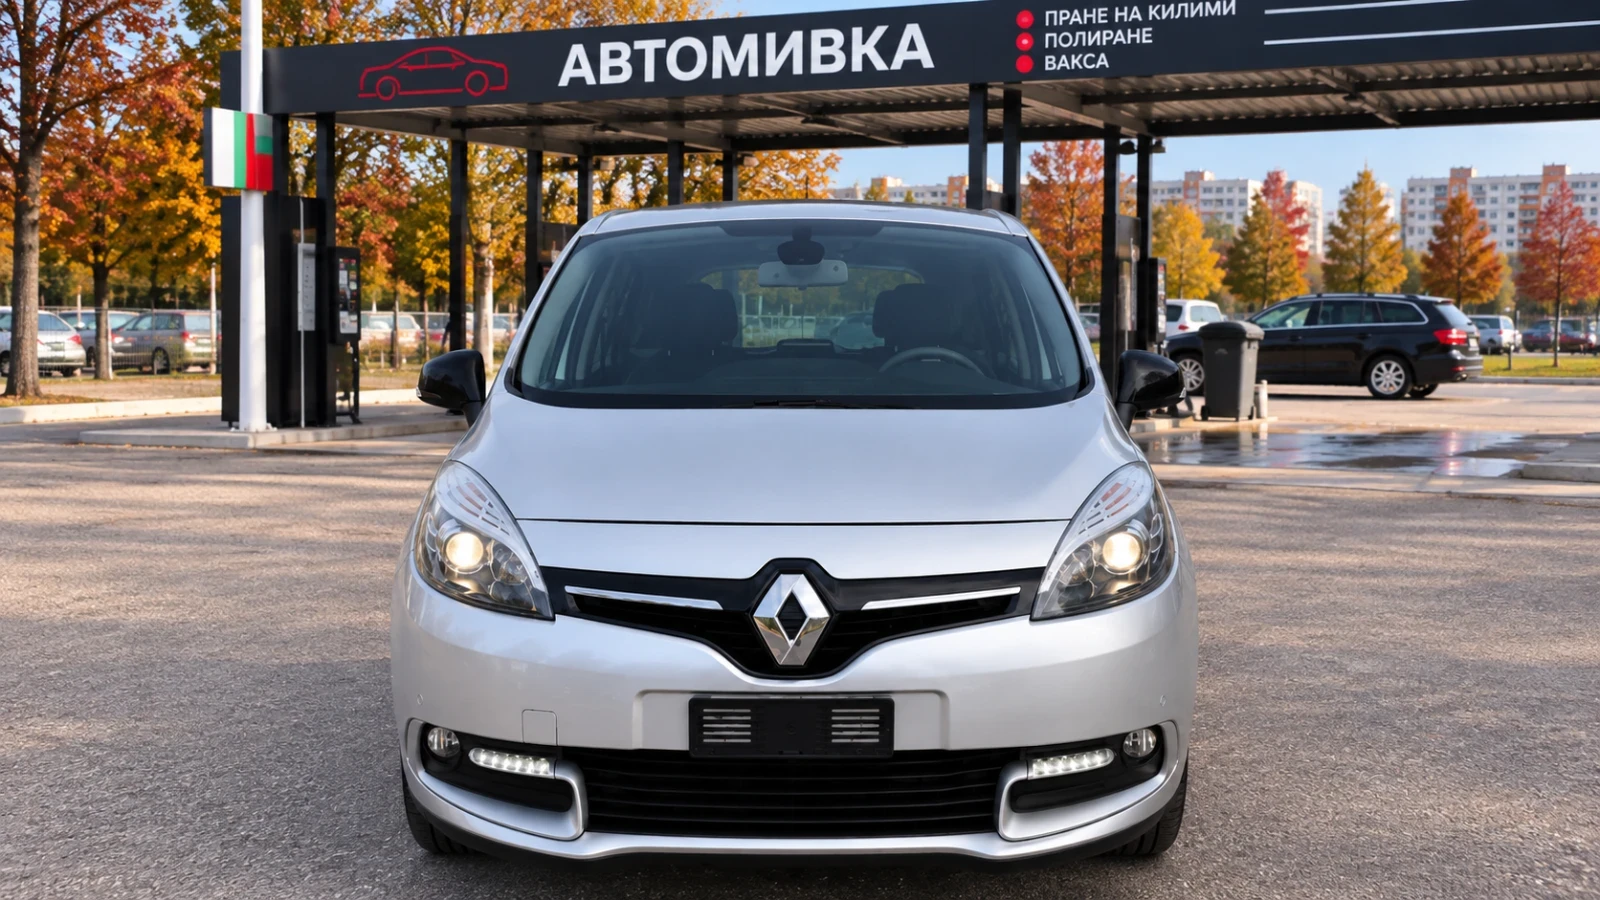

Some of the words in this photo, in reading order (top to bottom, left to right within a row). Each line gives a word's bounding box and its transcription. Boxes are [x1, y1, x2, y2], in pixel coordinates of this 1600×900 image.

[1044, 7, 1109, 27] ПРАНЕ
[1114, 5, 1143, 23] НА
[1148, 0, 1237, 21] КИЛИМИ
[1044, 27, 1153, 49] ПОЛИРАНЕ
[557, 22, 935, 87] АВТОМИВКА
[1044, 52, 1110, 71] ВАКСА
